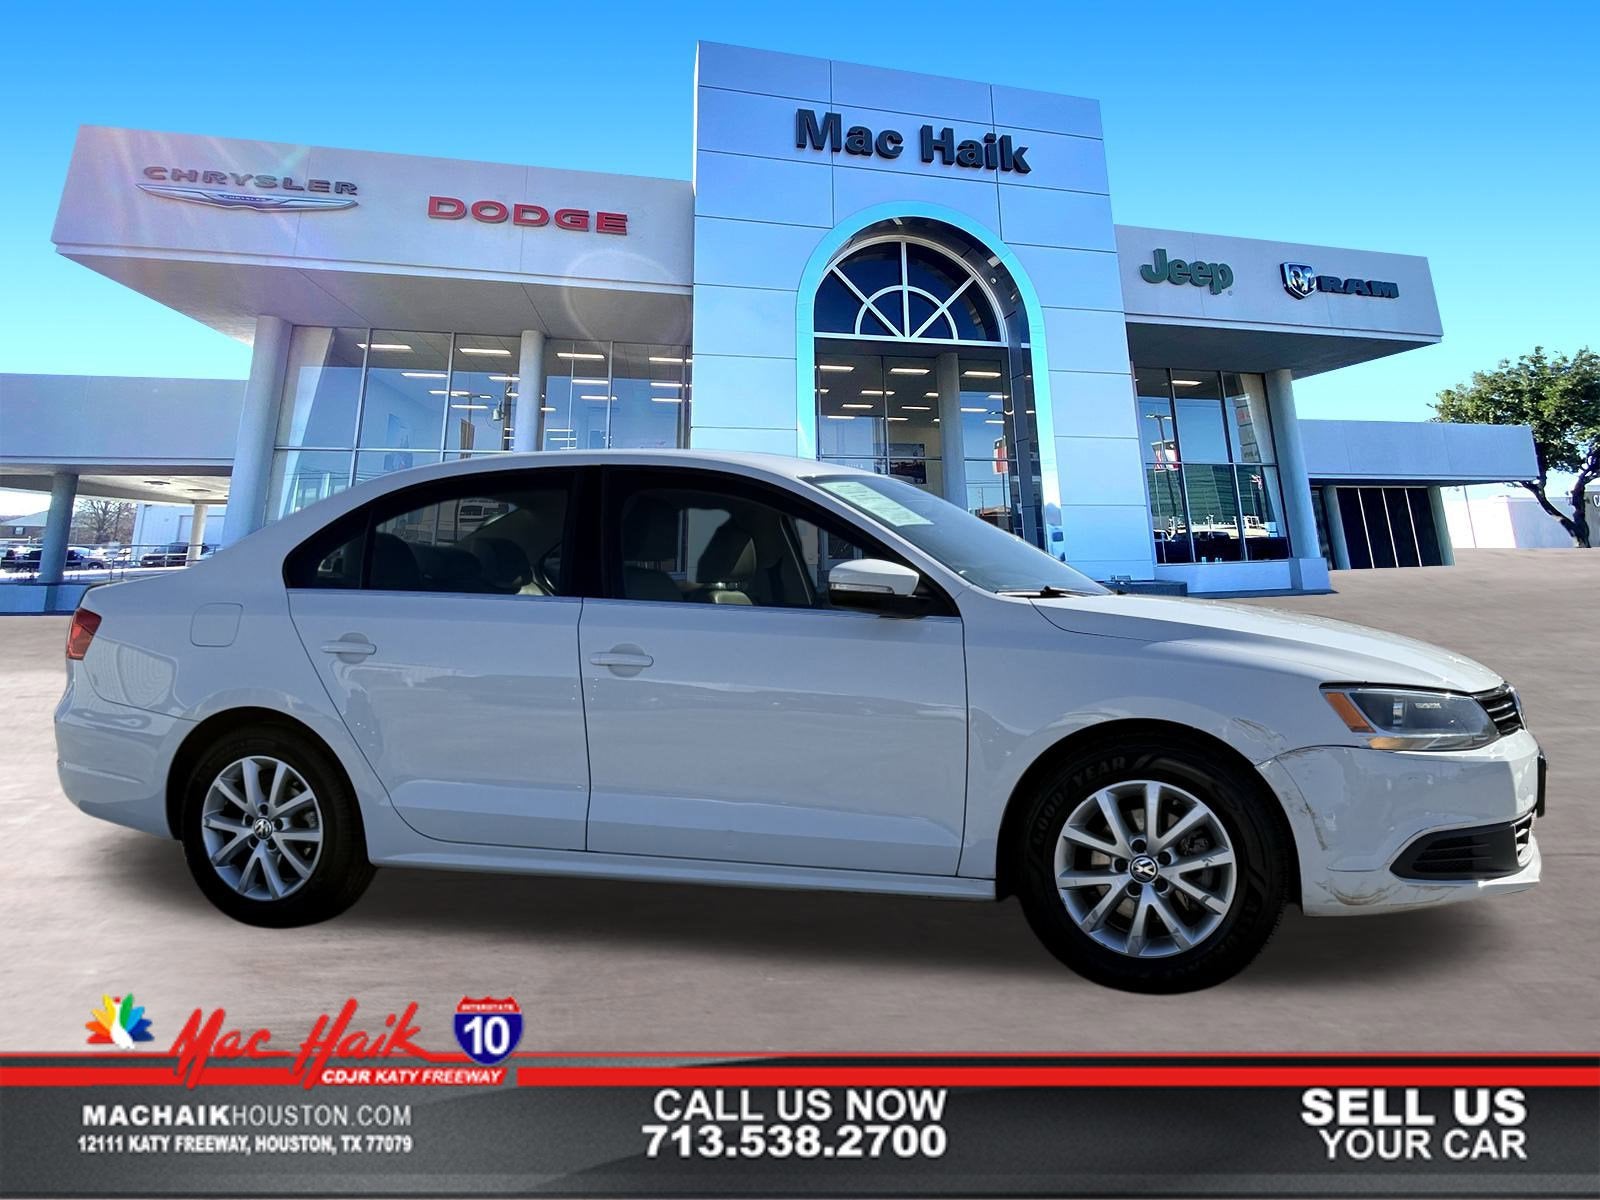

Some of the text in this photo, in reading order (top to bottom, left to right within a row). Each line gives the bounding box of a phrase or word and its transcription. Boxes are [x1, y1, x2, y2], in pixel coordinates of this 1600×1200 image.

[796, 107, 1032, 174] Mac Haik
[143, 165, 359, 197] CHRYSLER
[428, 195, 628, 236] DODGE
[1139, 248, 1234, 296] Jeep
[1316, 275, 1400, 299] RAM
